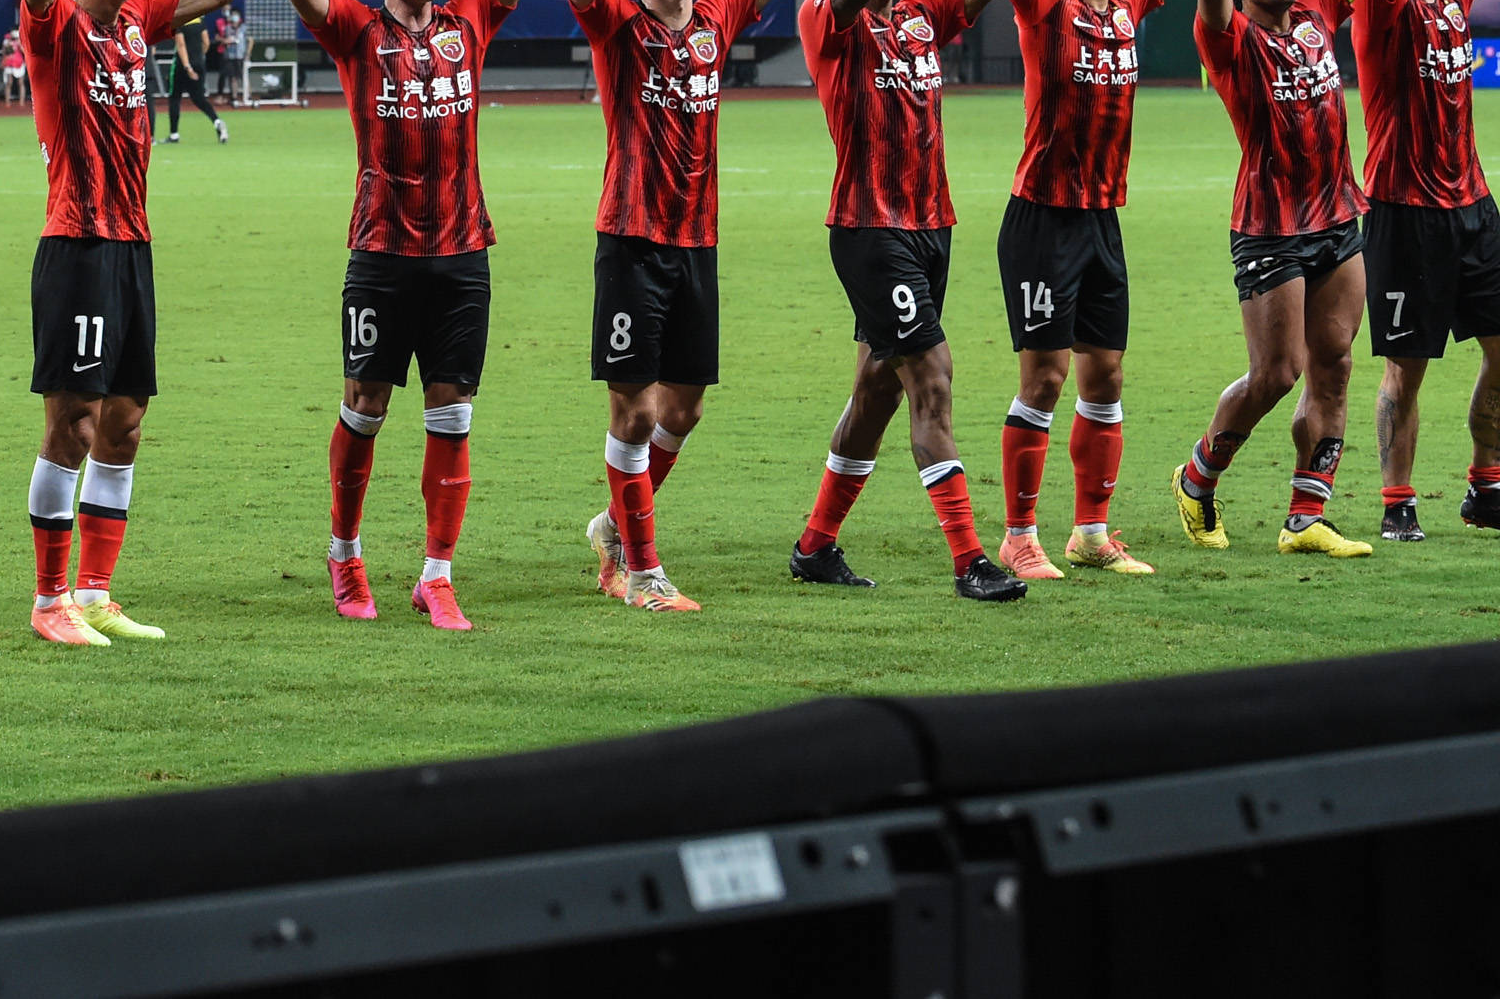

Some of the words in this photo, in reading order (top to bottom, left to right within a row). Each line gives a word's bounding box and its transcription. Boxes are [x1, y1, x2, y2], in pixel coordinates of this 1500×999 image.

[375, 70, 472, 102] 上汽集团
[1073, 70, 1108, 85] SAIC
[89, 89, 123, 108] SAIC
[376, 104, 417, 119] SAIC
[423, 98, 473, 119] MOTOR
[641, 91, 677, 109] SAIC
[1273, 88, 1307, 101] SAIC
[892, 284, 916, 323] 9
[1020, 281, 1054, 319] 14
[1386, 292, 1405, 327] 7
[74, 315, 104, 358] 11
[348, 307, 378, 347] 16
[610, 312, 631, 351] 8
